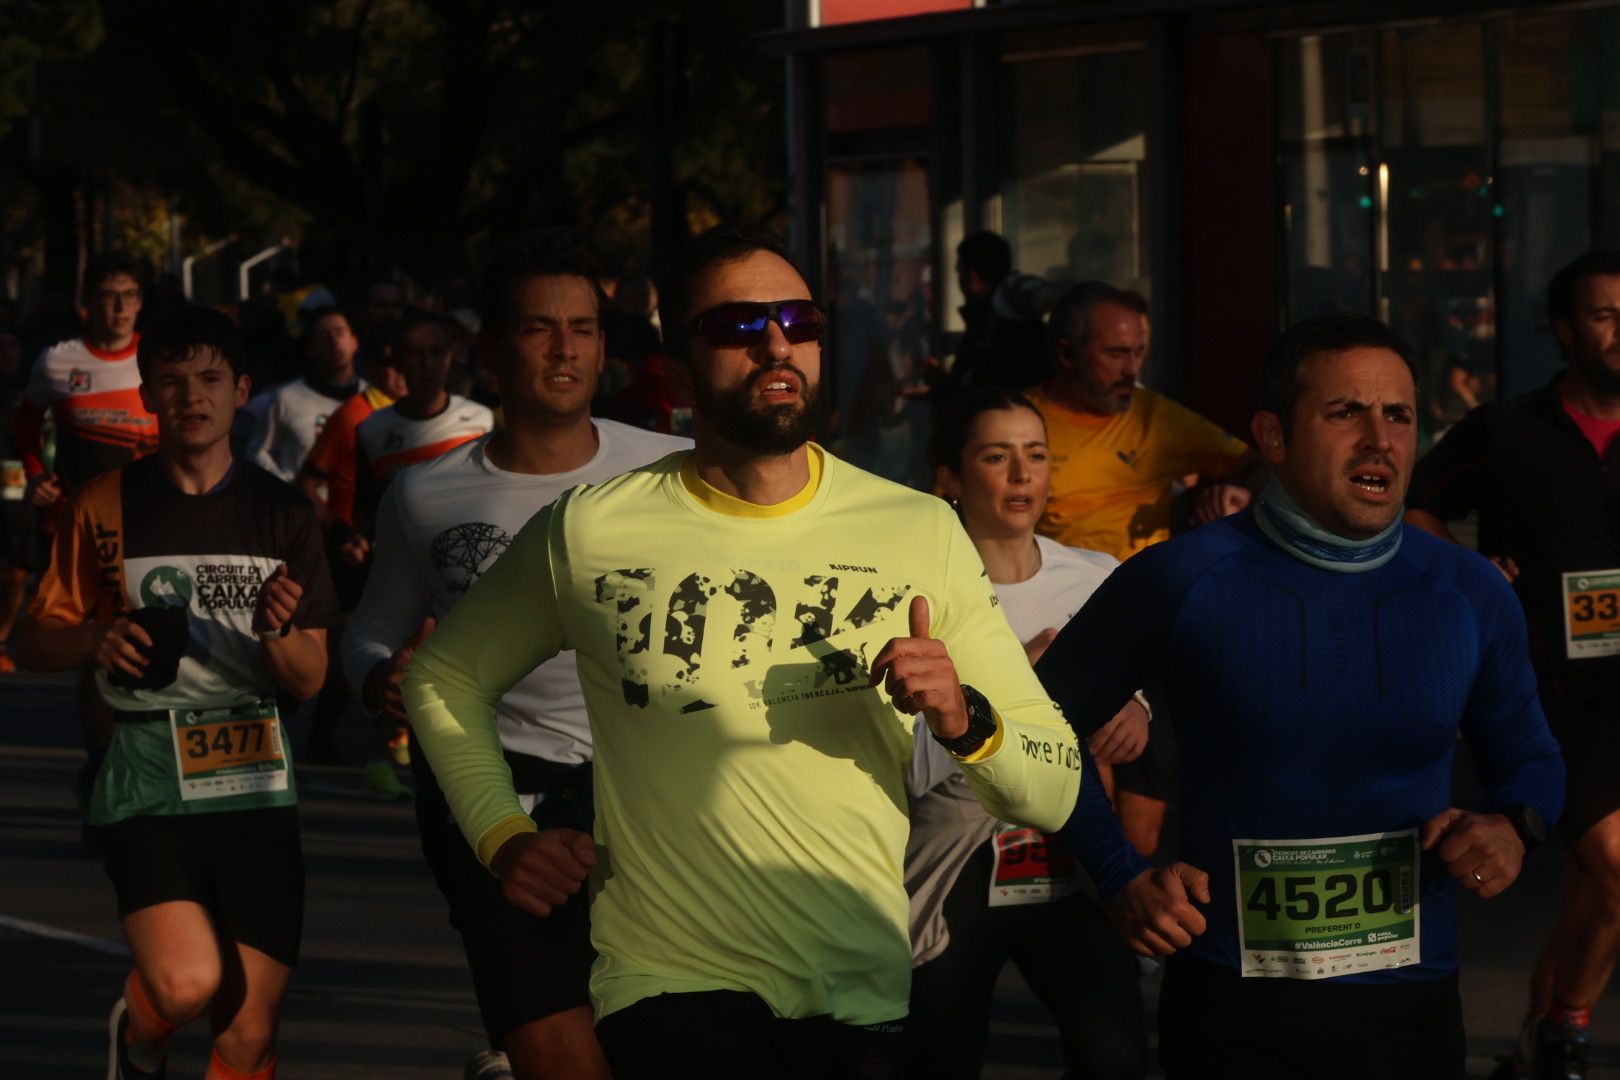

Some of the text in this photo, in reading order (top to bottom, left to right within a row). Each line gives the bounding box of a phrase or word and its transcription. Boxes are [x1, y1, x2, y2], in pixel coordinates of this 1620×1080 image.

[196, 565, 244, 574] CIRCUIT
[829, 564, 878, 574] KIPRUN
[197, 575, 262, 585] CARRERES
[198, 585, 259, 599] CAIXA
[187, 723, 264, 758] 3477
[1247, 870, 1393, 921] 4520
[1305, 923, 1352, 933] PREFERENT
